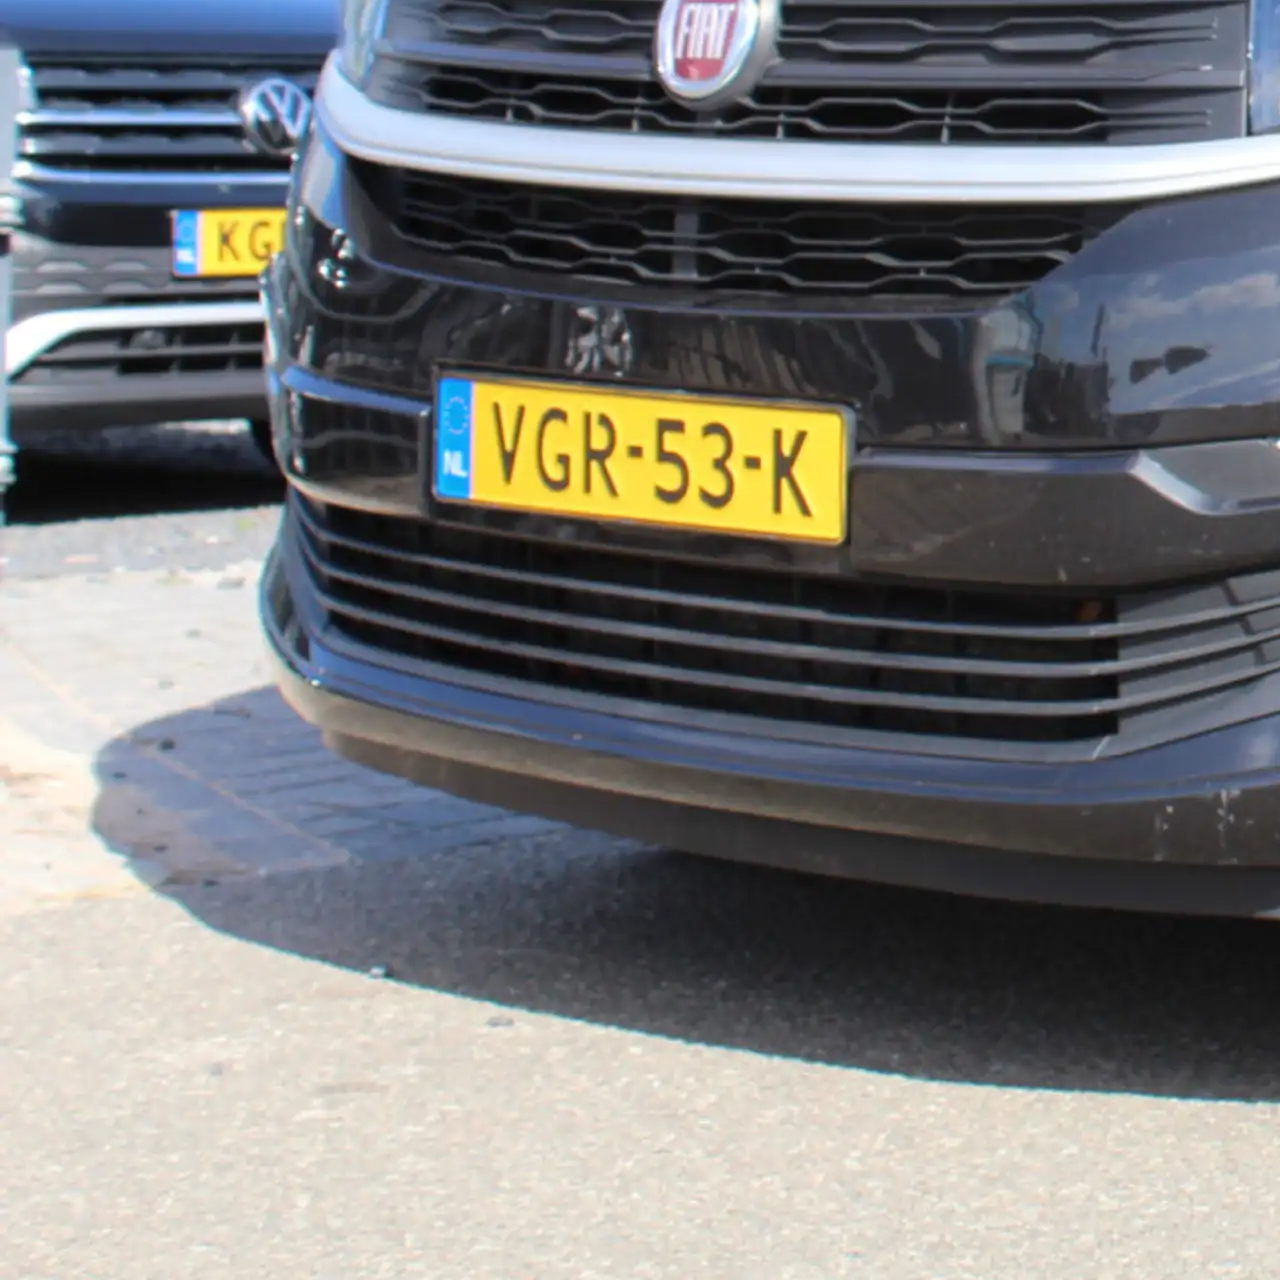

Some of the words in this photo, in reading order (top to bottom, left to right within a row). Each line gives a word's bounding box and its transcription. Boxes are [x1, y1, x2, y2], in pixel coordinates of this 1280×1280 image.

[673, 2, 738, 60] FIAT
[216, 220, 286, 262] KG
[443, 450, 468, 478] NL
[492, 401, 814, 518] VGR-53-K
